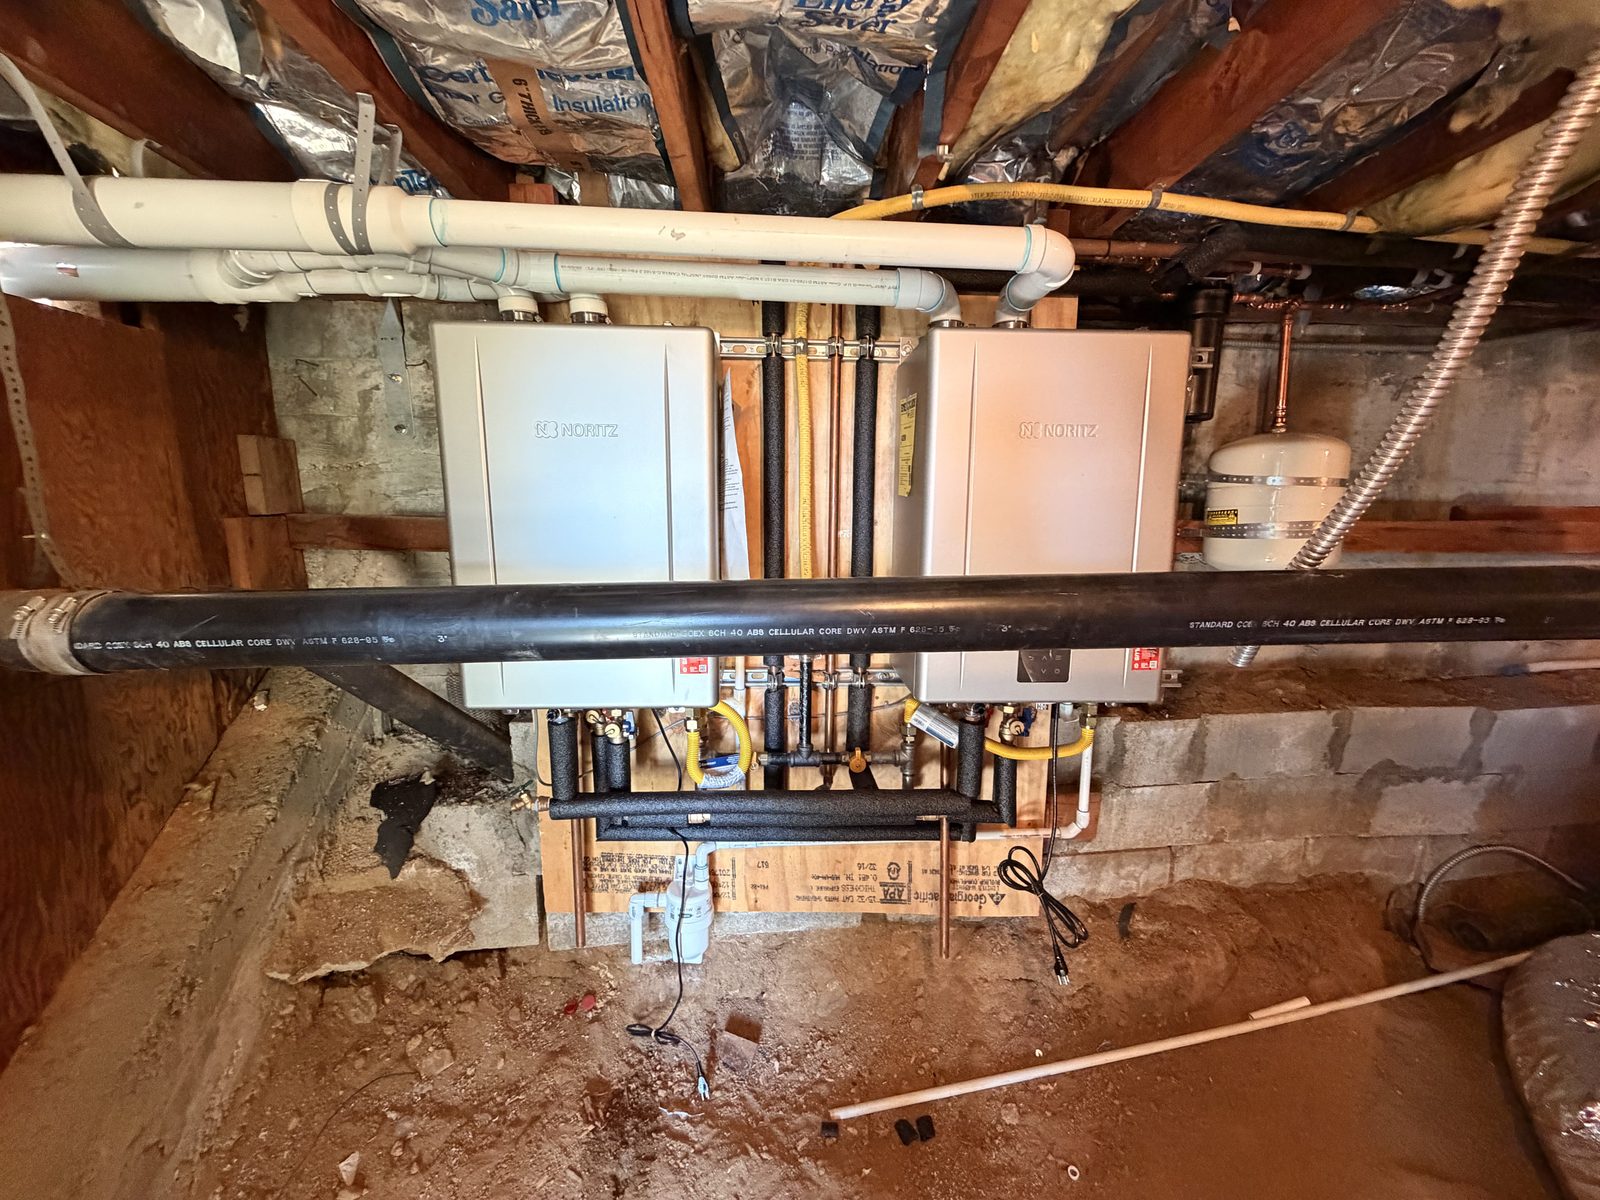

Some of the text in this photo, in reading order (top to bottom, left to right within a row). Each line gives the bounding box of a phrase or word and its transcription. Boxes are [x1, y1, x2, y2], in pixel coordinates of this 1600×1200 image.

[552, 92, 653, 114] Insulation
[561, 422, 619, 438] NORITZ
[1044, 423, 1098, 438] NORITZ
[1189, 620, 1234, 629] STANDARD
[1282, 619, 1296, 627] 40
[1298, 618, 1316, 627] ABS
[1320, 618, 1365, 627] CELLULAR
[1368, 618, 1392, 626] CORE
[1395, 617, 1415, 626] DWV
[1419, 616, 1445, 625] ASTM
[708, 628, 726, 637] SCH
[730, 628, 743, 637] 40
[746, 628, 765, 636] ABS
[768, 627, 815, 636] CELLULAR
[818, 627, 843, 635] CORE
[846, 626, 867, 635] DWV
[871, 625, 896, 634] ASTM
[900, 625, 906, 634] F
[155, 640, 170, 648] 40
[173, 640, 192, 648] ABS
[195, 639, 245, 648] CELLULAR
[247, 638, 273, 647] CORE
[276, 638, 296, 647] DWV
[302, 637, 328, 645] ASTM
[841, 884, 876, 893] THICKNESS
[882, 887, 904, 899] APA
